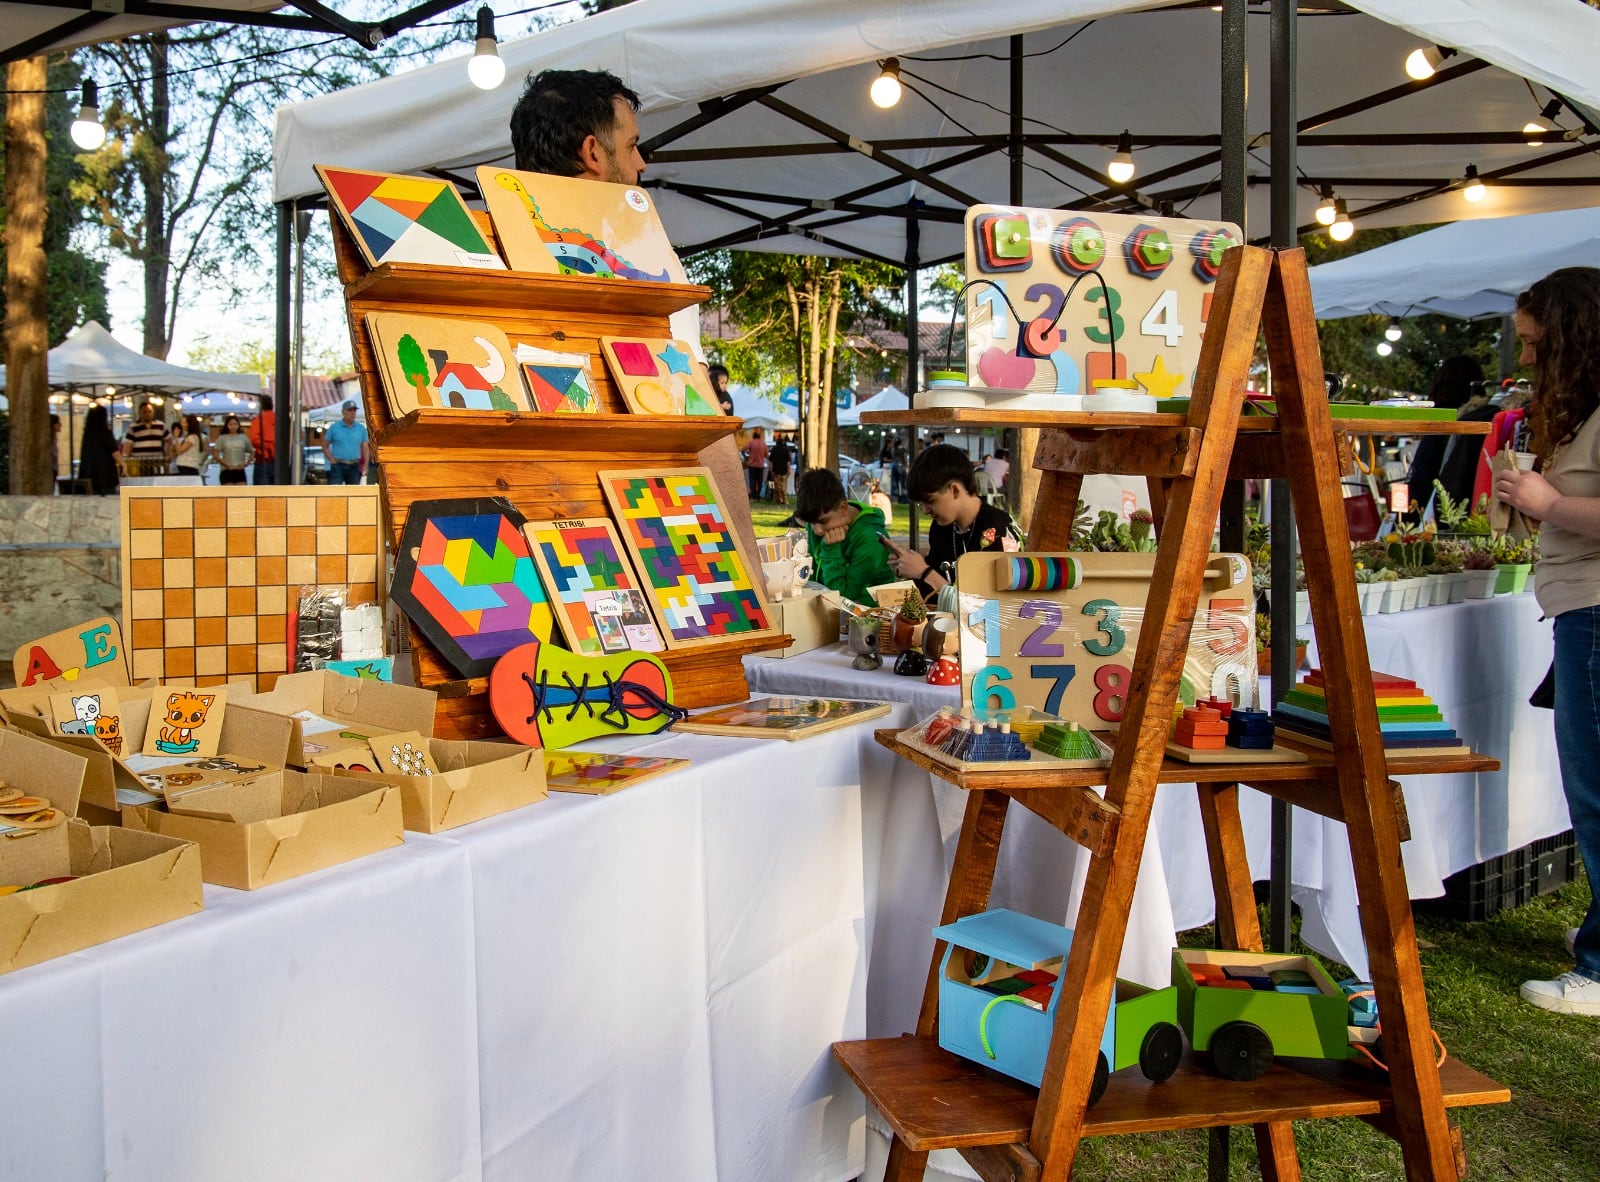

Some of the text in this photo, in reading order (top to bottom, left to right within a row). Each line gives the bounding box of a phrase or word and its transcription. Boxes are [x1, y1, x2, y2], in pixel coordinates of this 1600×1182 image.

[530, 211, 538, 219] 2
[555, 233, 563, 242] 3
[560, 246, 567, 254] 5
[573, 259, 579, 267] 7
[591, 256, 597, 265] 6
[976, 280, 1006, 339] 1
[1084, 287, 1125, 344] 3
[1141, 290, 1183, 347] 4
[552, 520, 585, 528] TETRIS!
[968, 599, 1248, 657] 1 2 3 5
[22, 624, 117, 687] A E
[971, 665, 1017, 724] 6
[1031, 664, 1075, 717] 7
[1093, 664, 1132, 722] 8
